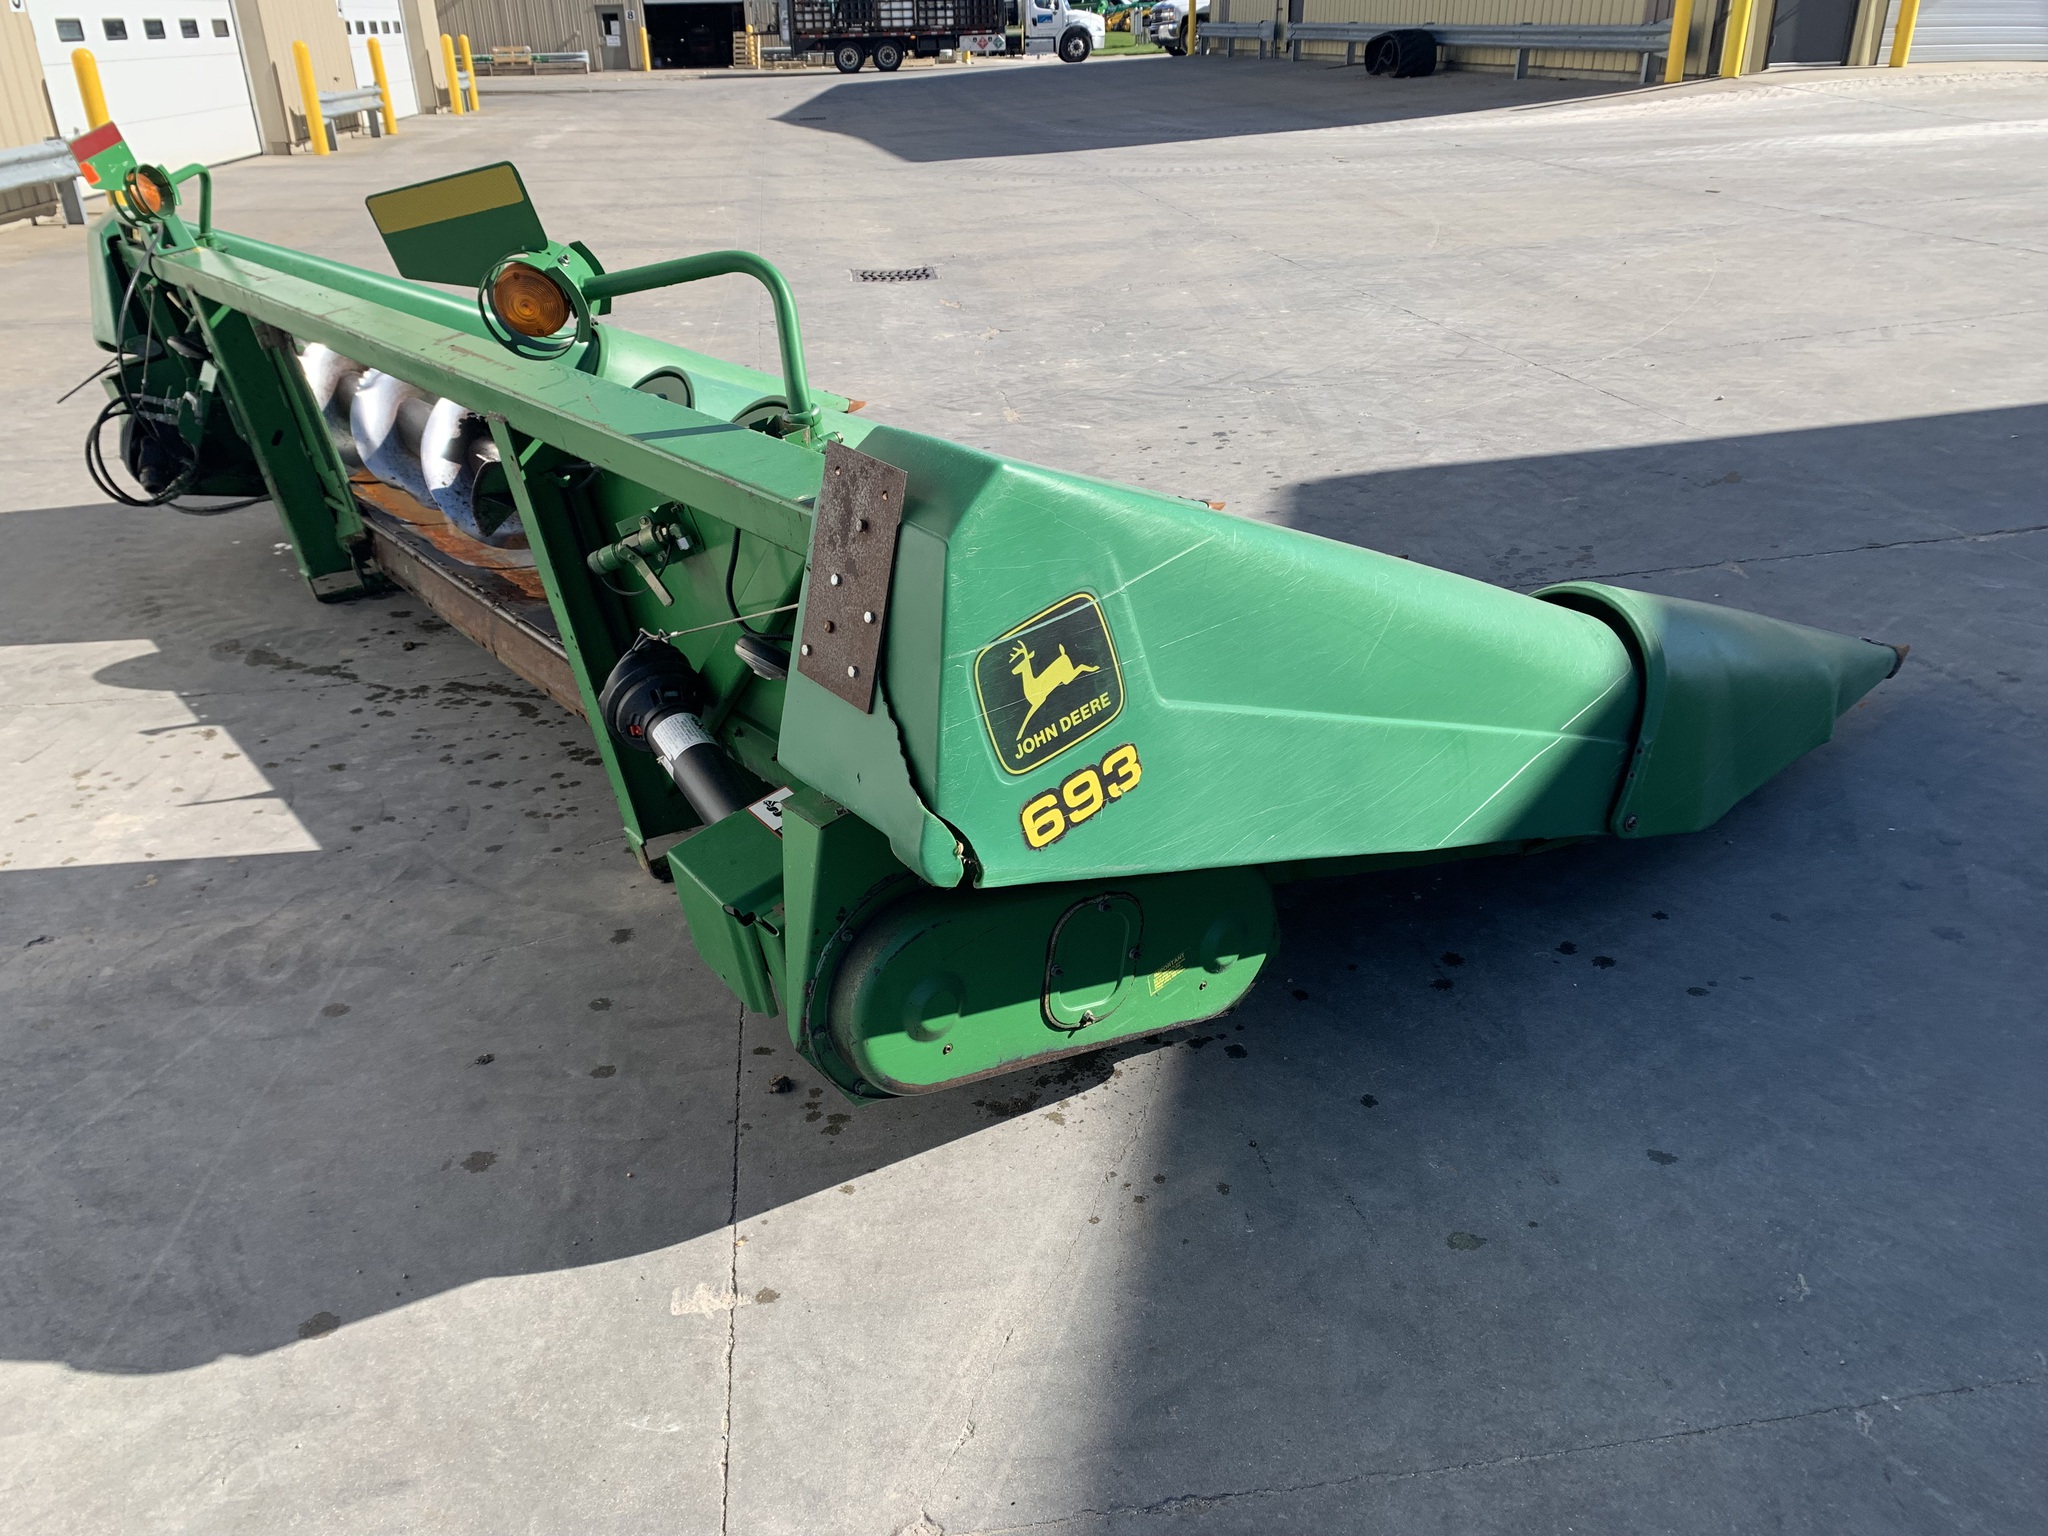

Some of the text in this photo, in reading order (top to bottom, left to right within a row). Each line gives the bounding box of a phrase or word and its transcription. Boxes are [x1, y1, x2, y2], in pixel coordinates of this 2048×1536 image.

[627, 11, 634, 20] 8
[1015, 691, 1111, 759] JOHN DEERE
[1021, 744, 1142, 848] 693
